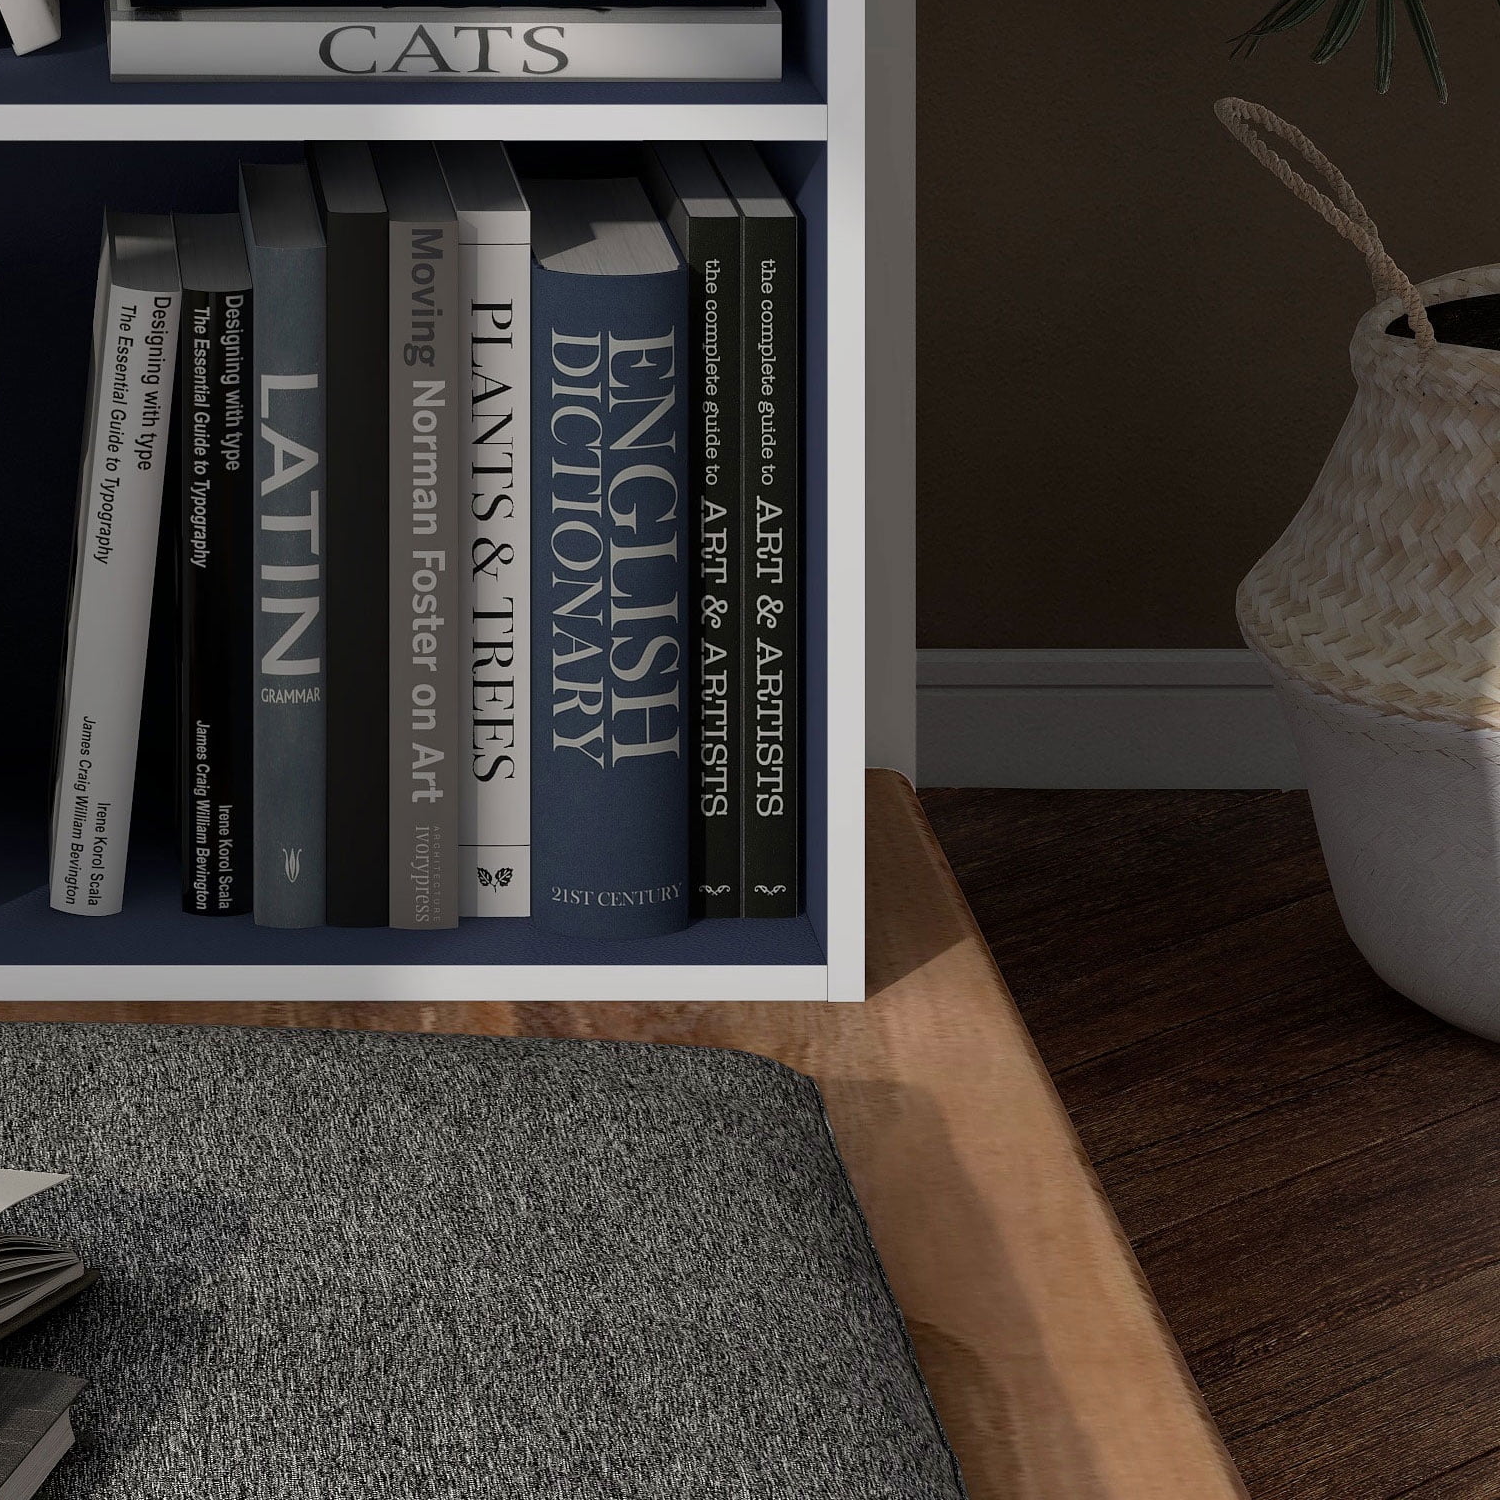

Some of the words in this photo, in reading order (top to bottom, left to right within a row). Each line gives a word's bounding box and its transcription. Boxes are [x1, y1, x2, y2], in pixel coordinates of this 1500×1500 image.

[318, 24, 569, 76] CATS
[403, 228, 444, 368] Moving
[705, 258, 720, 294] the
[761, 258, 776, 294] the
[119, 304, 137, 332] The
[194, 306, 211, 335] The
[220, 295, 244, 386] Designing
[141, 296, 172, 386] Designing
[702, 299, 720, 396] complete
[758, 299, 776, 396] complete
[112, 336, 134, 405] Essential
[194, 338, 211, 408] Essential
[107, 407, 127, 452] Guide
[144, 389, 161, 428] with
[225, 389, 244, 428] with
[471, 298, 515, 522] PLANTS
[702, 401, 720, 459] guide
[758, 401, 776, 459] guide
[134, 429, 157, 471] type
[194, 411, 211, 456] Guide
[220, 431, 244, 472] type
[106, 457, 120, 472] to
[194, 460, 210, 476] to
[411, 380, 446, 536] Norman
[705, 464, 720, 486] to
[761, 464, 776, 486] to
[93, 476, 120, 565] Typography
[190, 479, 211, 569] Typography
[260, 373, 321, 676] LATIN
[700, 495, 728, 584] ART
[756, 495, 784, 584] ART
[471, 537, 515, 582] &
[550, 327, 605, 770] DICTIONARY
[607, 324, 681, 769] ENGLISH
[411, 550, 446, 672] Foster
[700, 594, 728, 629] &
[756, 594, 784, 629] &
[260, 686, 321, 704] GRAMMAR
[411, 683, 438, 731] on
[471, 596, 515, 783] TREES
[80, 716, 97, 756] James
[196, 720, 211, 760] James
[700, 637, 728, 817] ARTISTS
[756, 637, 784, 817] ARTISTS
[74, 759, 92, 792] Craig
[193, 763, 211, 797] Craig
[411, 742, 445, 804] Art
[72, 795, 89, 839] William
[95, 802, 111, 833] Irene
[196, 799, 211, 844] William
[218, 804, 233, 836] Irene
[64, 843, 84, 905] Bevington
[92, 837, 109, 870] Korol
[218, 838, 233, 872] Korol
[433, 825, 441, 922] ARCHITECTURE
[88, 873, 104, 906] Scala
[193, 847, 211, 910] Bevington
[218, 875, 233, 909] Scala
[551, 886, 594, 905] 21ST
[597, 882, 682, 907] CENTURY
